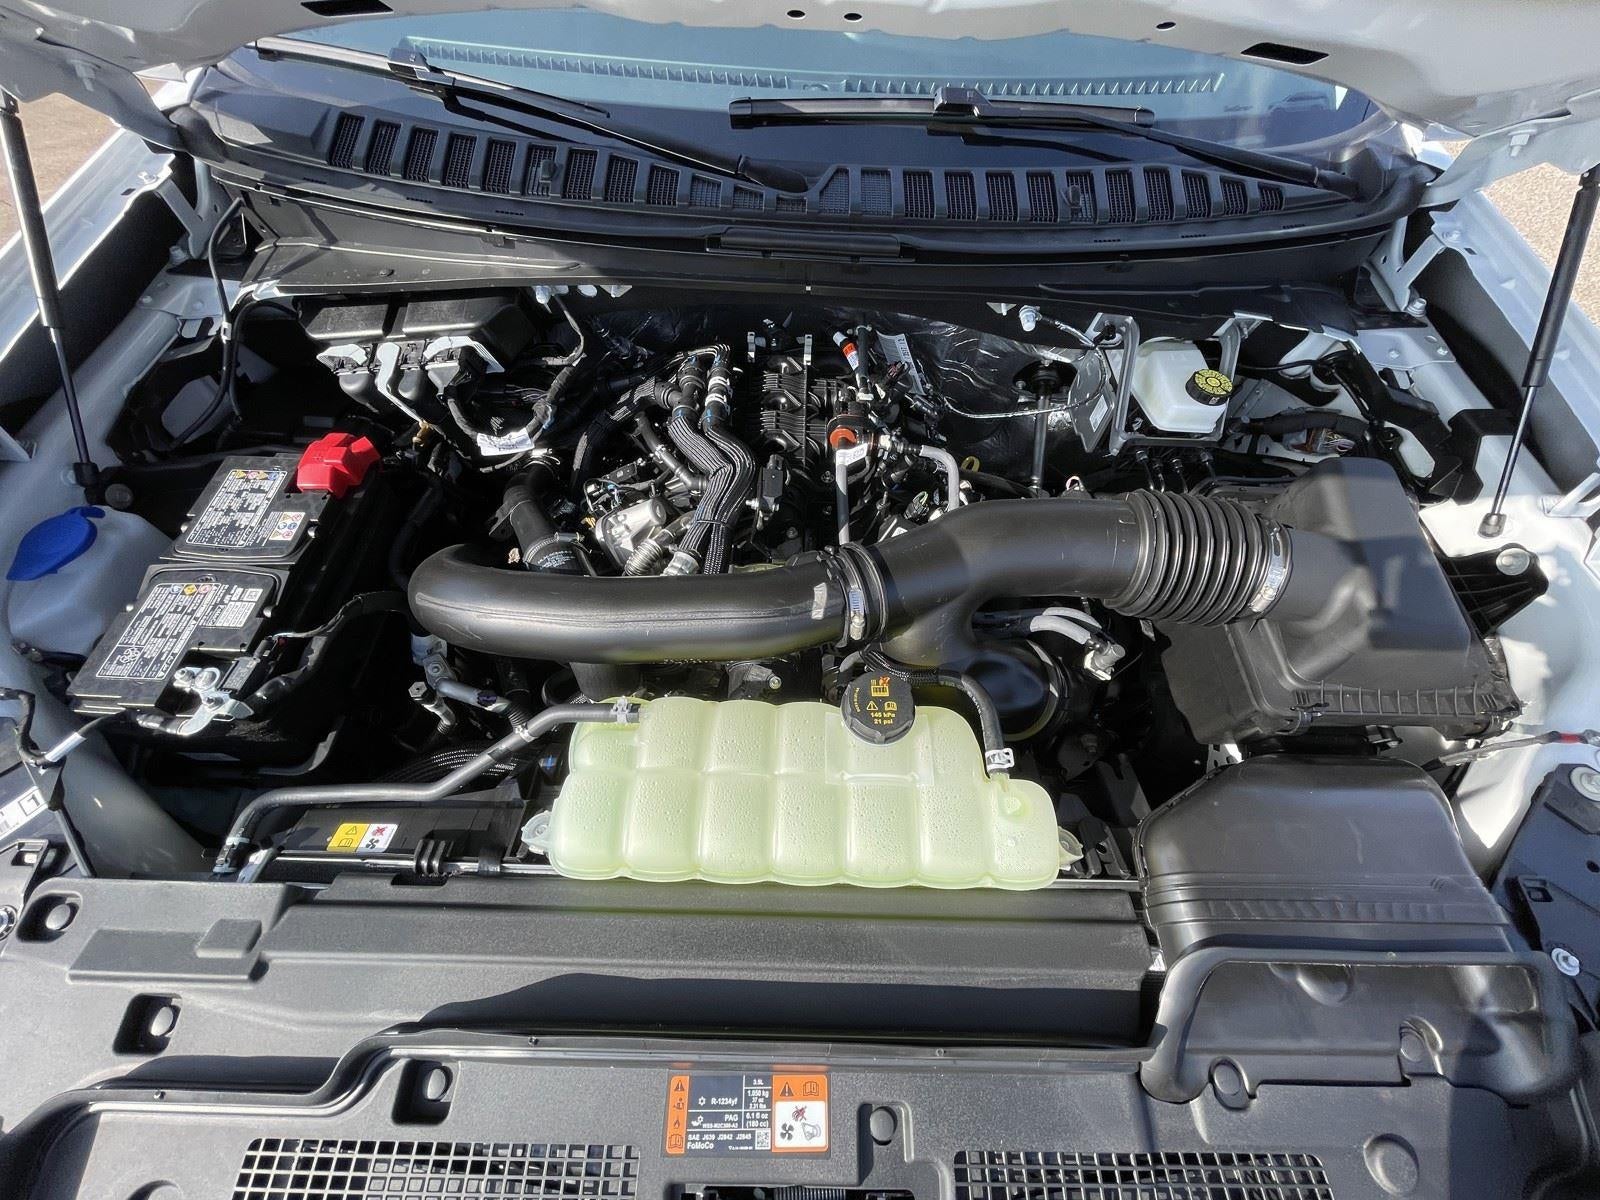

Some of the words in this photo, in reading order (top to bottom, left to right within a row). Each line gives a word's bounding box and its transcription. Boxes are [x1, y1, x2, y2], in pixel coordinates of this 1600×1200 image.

[762, 1090, 769, 1098] kg
[711, 1097, 738, 1106] R-1234yf
[724, 1114, 739, 1122] PAG
[746, 1120, 759, 1128] (180
[760, 1120, 769, 1128] cc)
[687, 1141, 714, 1149] FoMoCo
